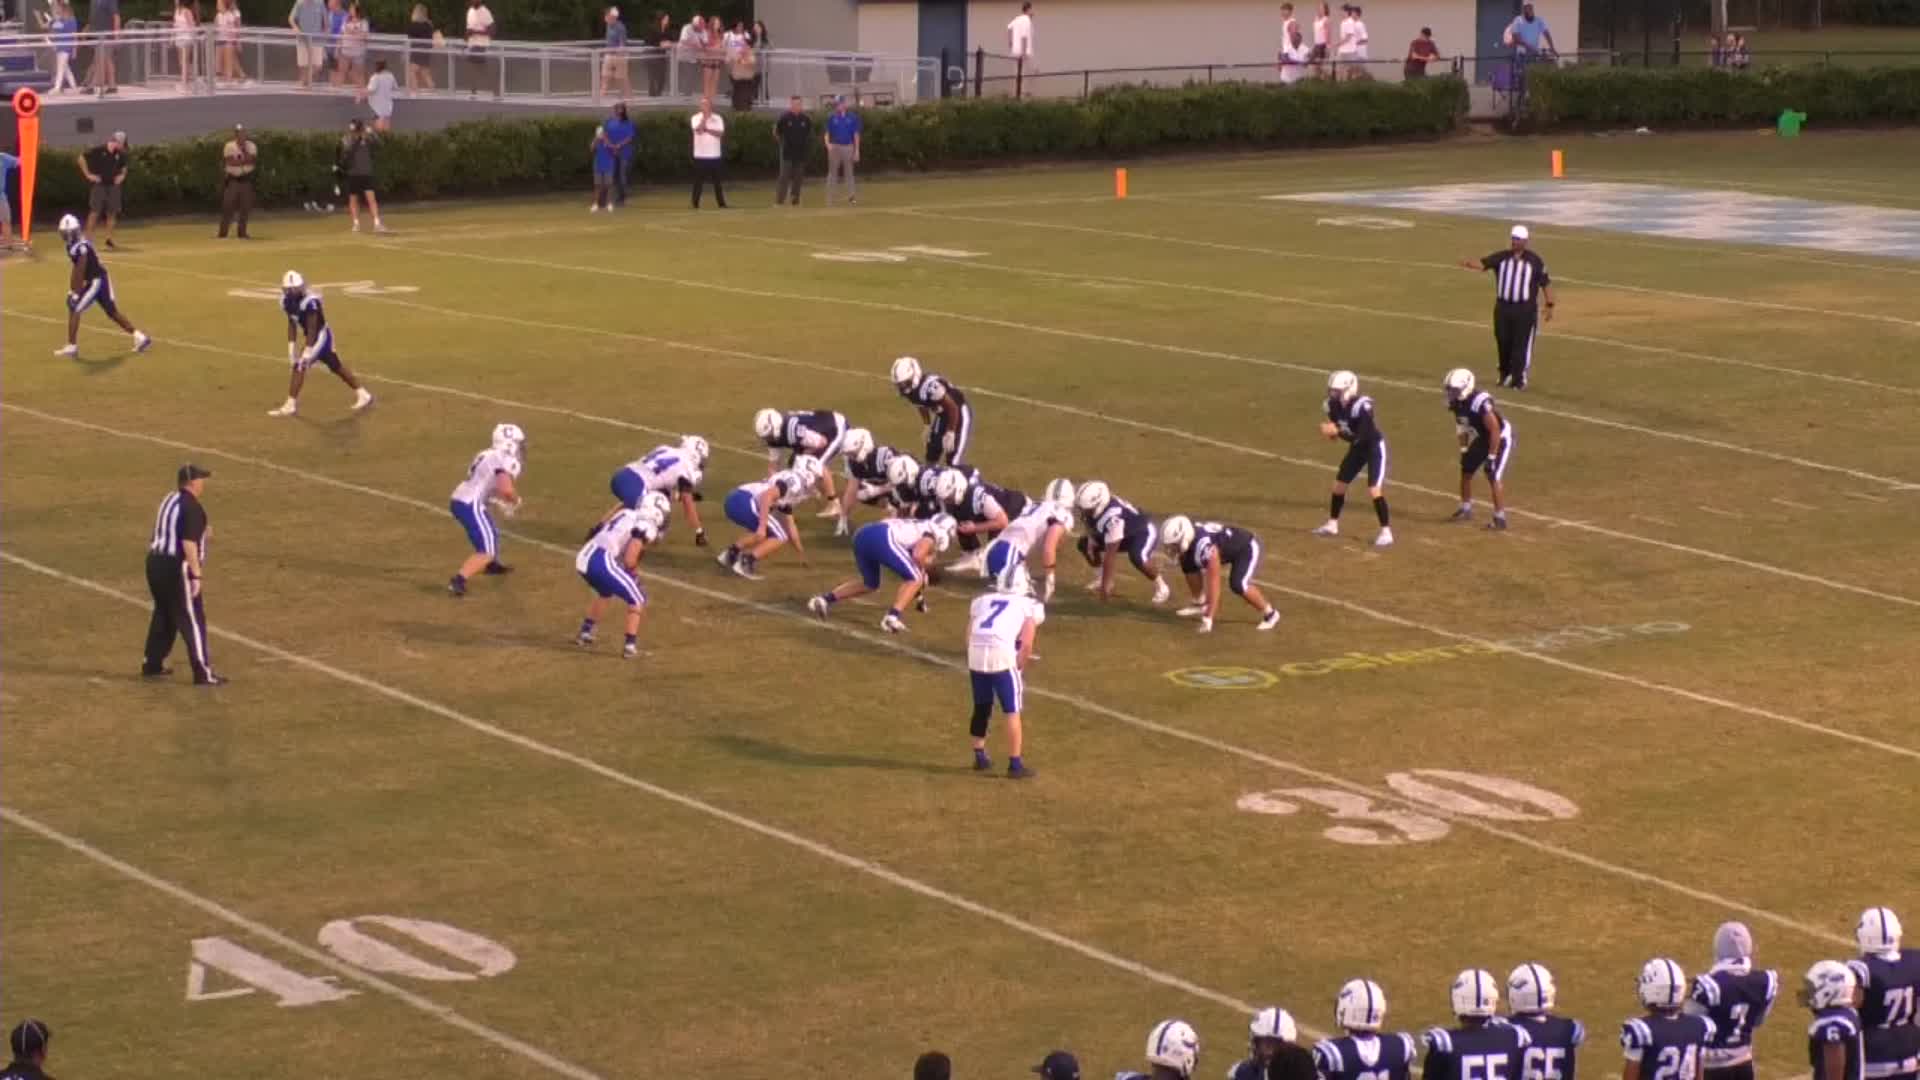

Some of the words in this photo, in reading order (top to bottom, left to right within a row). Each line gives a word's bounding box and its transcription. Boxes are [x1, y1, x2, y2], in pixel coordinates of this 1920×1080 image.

[980, 600, 1009, 629] 7
[1236, 768, 1580, 845] 30
[186, 914, 517, 1007] 40
[1883, 986, 1914, 1029] 71
[1521, 1047, 1566, 1080] 65
[1653, 1043, 1698, 1080] 24
